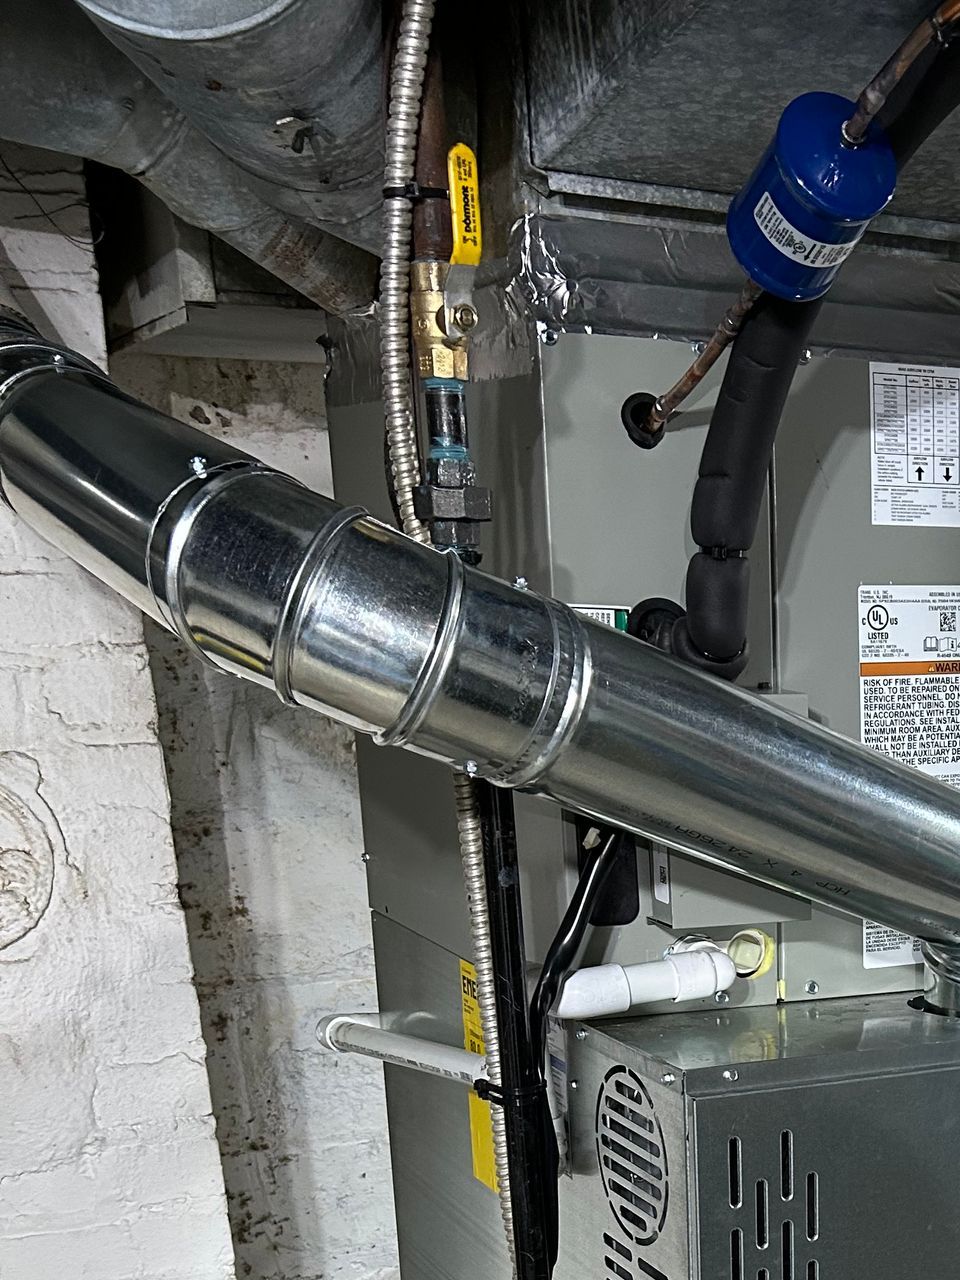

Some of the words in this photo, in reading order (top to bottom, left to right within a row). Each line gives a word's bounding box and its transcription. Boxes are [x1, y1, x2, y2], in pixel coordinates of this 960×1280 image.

[868, 632, 889, 640] LISTED
[864, 679, 881, 687] RISK
[883, 678, 893, 686] OF
[915, 676, 959, 685] FLAMMABLE
[900, 686, 910, 694] BE
[911, 685, 947, 694] REPAIRED
[864, 695, 896, 703] SERVICE
[945, 692, 955, 700] DO
[864, 702, 915, 711] REFRIGERANT
[873, 710, 925, 719] ACCORDANCE
[926, 709, 944, 717] WITH
[919, 717, 934, 725] SEE
[864, 727, 897, 735] MINIMUM
[898, 726, 920, 734] ROOM
[864, 735, 889, 744] WHICH
[907, 742, 917, 750] BE
[919, 740, 957, 749] INSTALLED
[892, 750, 911, 758] THAN
[913, 748, 950, 757] AUXILIARY
[917, 756, 950, 765] SPECIFIC
